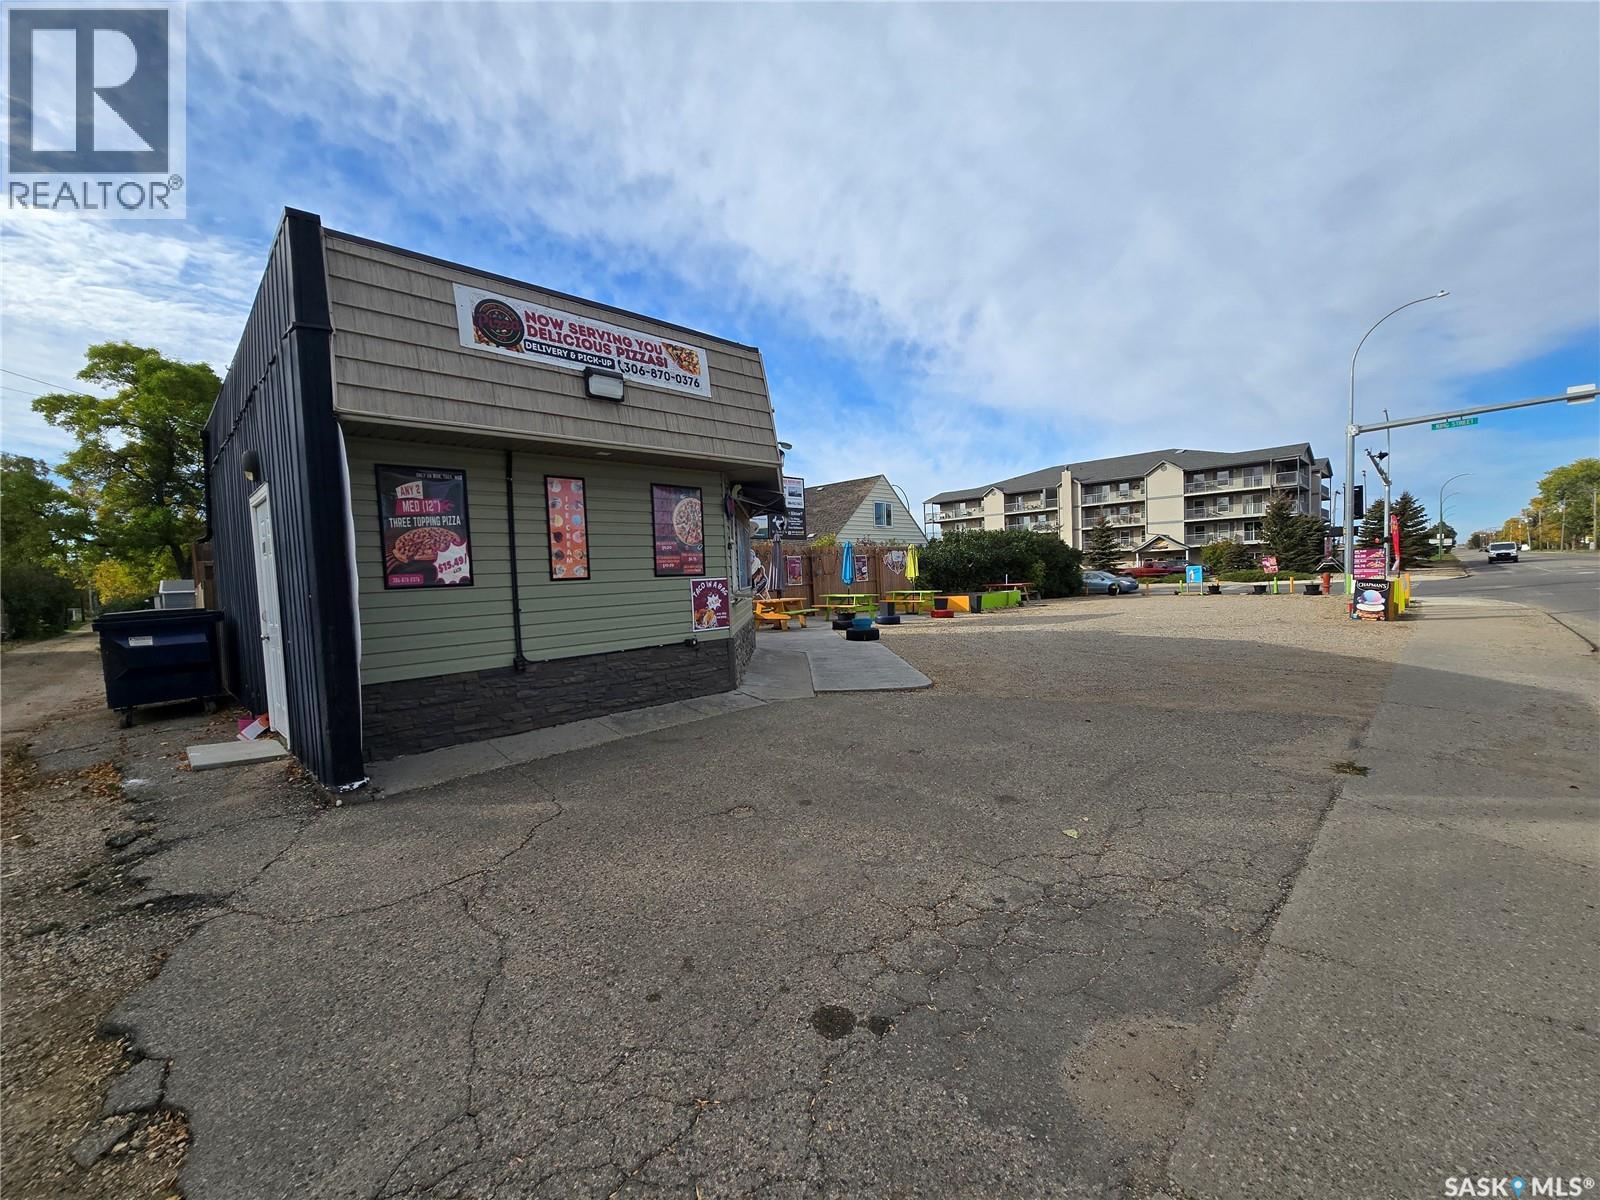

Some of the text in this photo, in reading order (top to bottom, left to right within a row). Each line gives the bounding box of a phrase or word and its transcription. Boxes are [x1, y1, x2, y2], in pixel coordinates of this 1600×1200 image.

[524, 310, 564, 331] NOW
[568, 322, 633, 348] SERVING
[634, 338, 663, 355] YOU
[526, 323, 612, 355] DELICIOUS
[525, 341, 613, 367] DELIVERY & PICK-UP
[623, 361, 700, 388] 306-870-0376
[400, 484, 421, 497] ANY 2
[401, 500, 420, 512] MED
[389, 515, 461, 528] THREE TOPPING PIZZA
[692, 582, 706, 598] TACO
[713, 581, 718, 589] A
[717, 583, 728, 596] BAG
